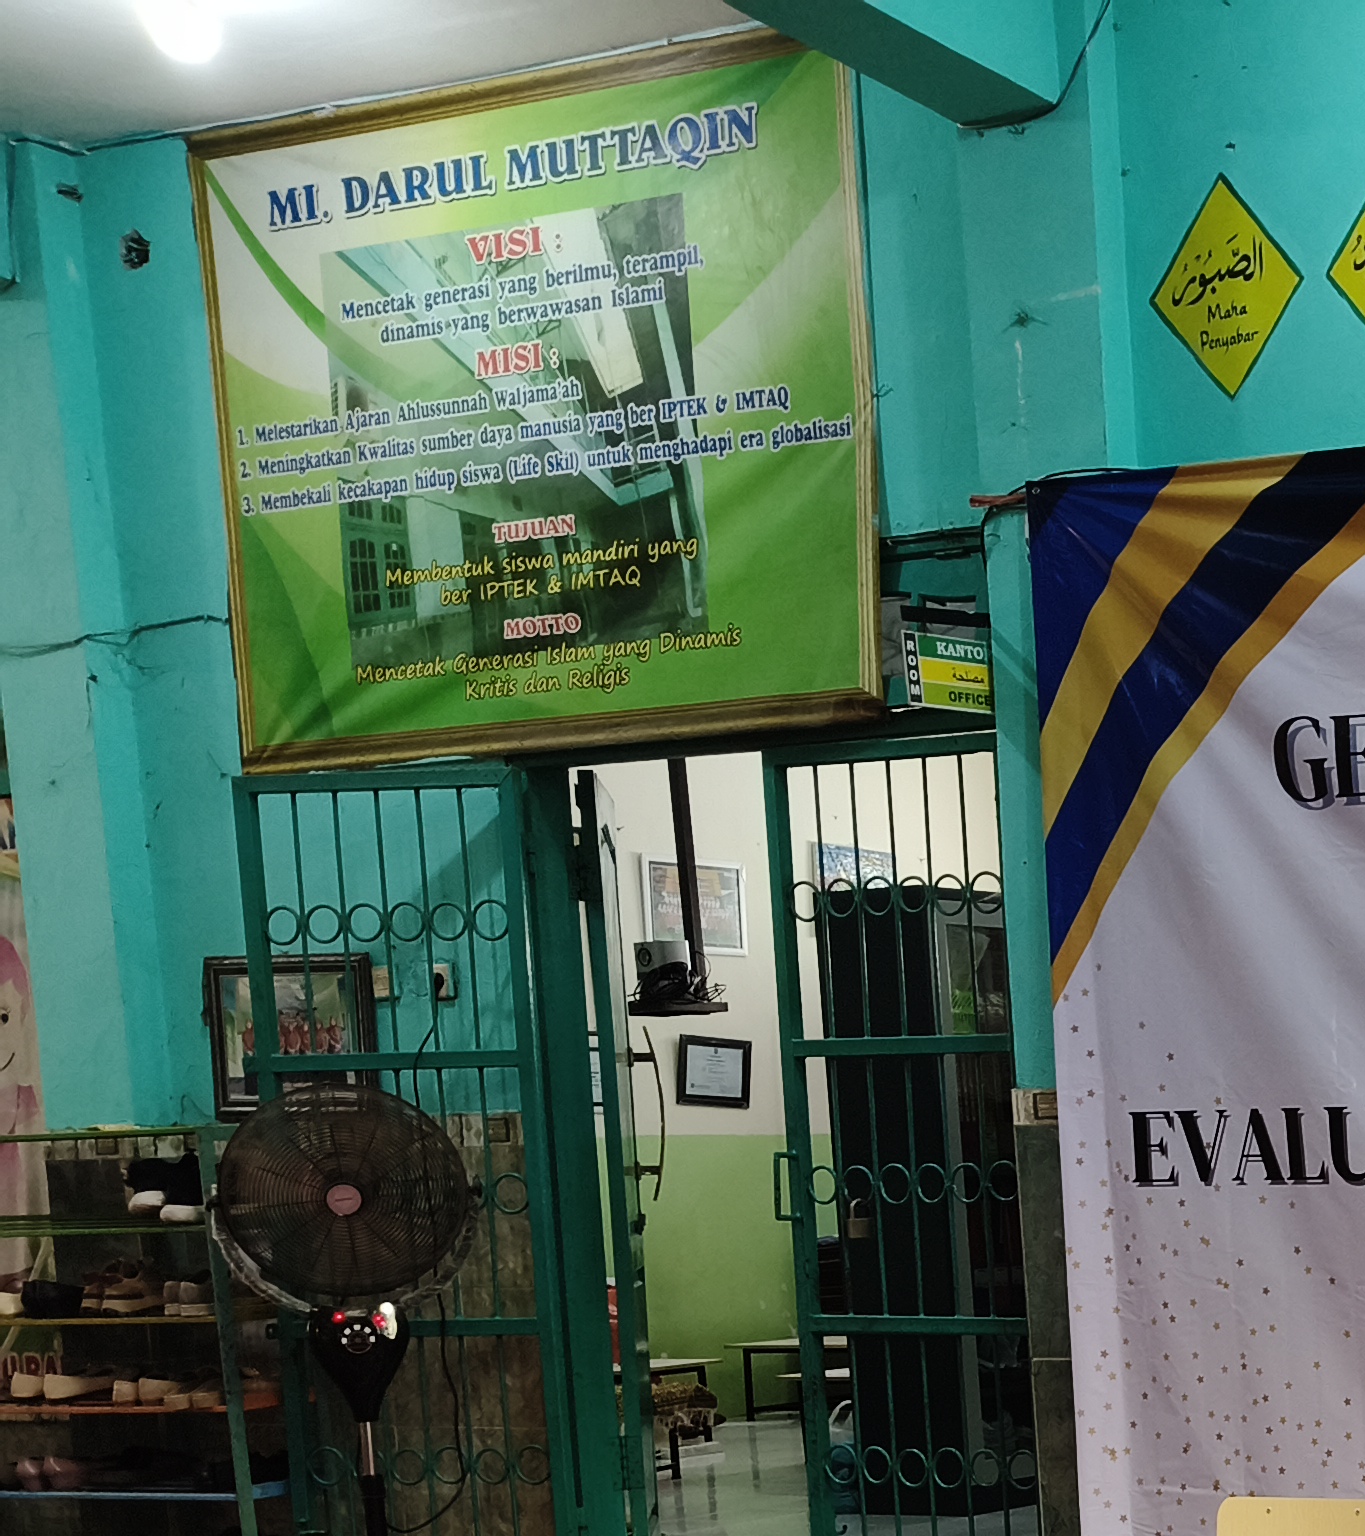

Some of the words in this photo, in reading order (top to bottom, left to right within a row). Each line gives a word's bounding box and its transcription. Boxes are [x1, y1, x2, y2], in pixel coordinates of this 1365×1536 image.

[267, 183, 332, 230] MI.
[342, 154, 495, 217] DARUL
[506, 103, 759, 188] MUTTAQIN
[467, 226, 543, 263] VISI
[341, 293, 414, 320] Mencetak
[424, 279, 491, 312] generasi
[499, 275, 537, 298] yang
[545, 261, 618, 289] berilmu,
[624, 245, 704, 277] terampil,
[380, 321, 444, 344] dinamis
[450, 314, 489, 336] yang
[497, 293, 602, 326] berwawasan
[611, 279, 666, 308] Islami
[1208, 299, 1247, 323] Maha
[474, 342, 543, 379] MISI
[1200, 326, 1259, 354] Penyabar
[238, 429, 250, 447] 1.
[255, 418, 339, 444] Melestarikan
[345, 410, 391, 432] Ajaran
[397, 393, 488, 423] Ahlussunnah
[494, 377, 582, 409] Waljama'ah
[240, 462, 251, 480] 2.
[258, 450, 351, 476] Meningkatkan
[357, 438, 415, 461] Kwalitas
[421, 429, 473, 452] sumber
[480, 422, 513, 447] daya
[520, 413, 582, 439] manusia
[588, 410, 623, 434] yang
[629, 404, 654, 425] ber
[661, 397, 708, 421] IPTEK
[734, 386, 790, 412] IMTAQ
[242, 496, 255, 515] 3.
[261, 485, 331, 512] Membekali
[338, 475, 408, 501] kecakapan
[415, 467, 455, 492] hidup
[462, 463, 501, 485] siswa
[508, 456, 540, 483] (Life
[546, 452, 582, 475] Skil)
[587, 446, 632, 468] untuk
[639, 432, 733, 462] menghadapi
[740, 431, 764, 450] era
[772, 414, 852, 451] globalisasi
[492, 514, 576, 543] TUJUAN
[386, 556, 495, 588] Membentuk
[502, 549, 554, 574] siswa
[563, 537, 638, 566] mandiri
[648, 536, 698, 563] yang
[440, 582, 472, 606] ber
[480, 577, 537, 601] IPTEK
[547, 574, 562, 593] &
[571, 565, 641, 591] IMTAQ
[503, 612, 582, 640] MOTTO
[355, 652, 445, 685] Mencetak
[454, 644, 539, 674] Generasi
[546, 640, 596, 666] Islam
[602, 637, 651, 664] yang
[659, 623, 741, 652] Dinamis
[906, 640, 920, 696] ROOM
[936, 641, 988, 661] KANTO
[465, 670, 518, 701] Kritis
[523, 670, 560, 694] dan
[567, 664, 630, 694] Religis
[949, 691, 990, 706] OFFICE
